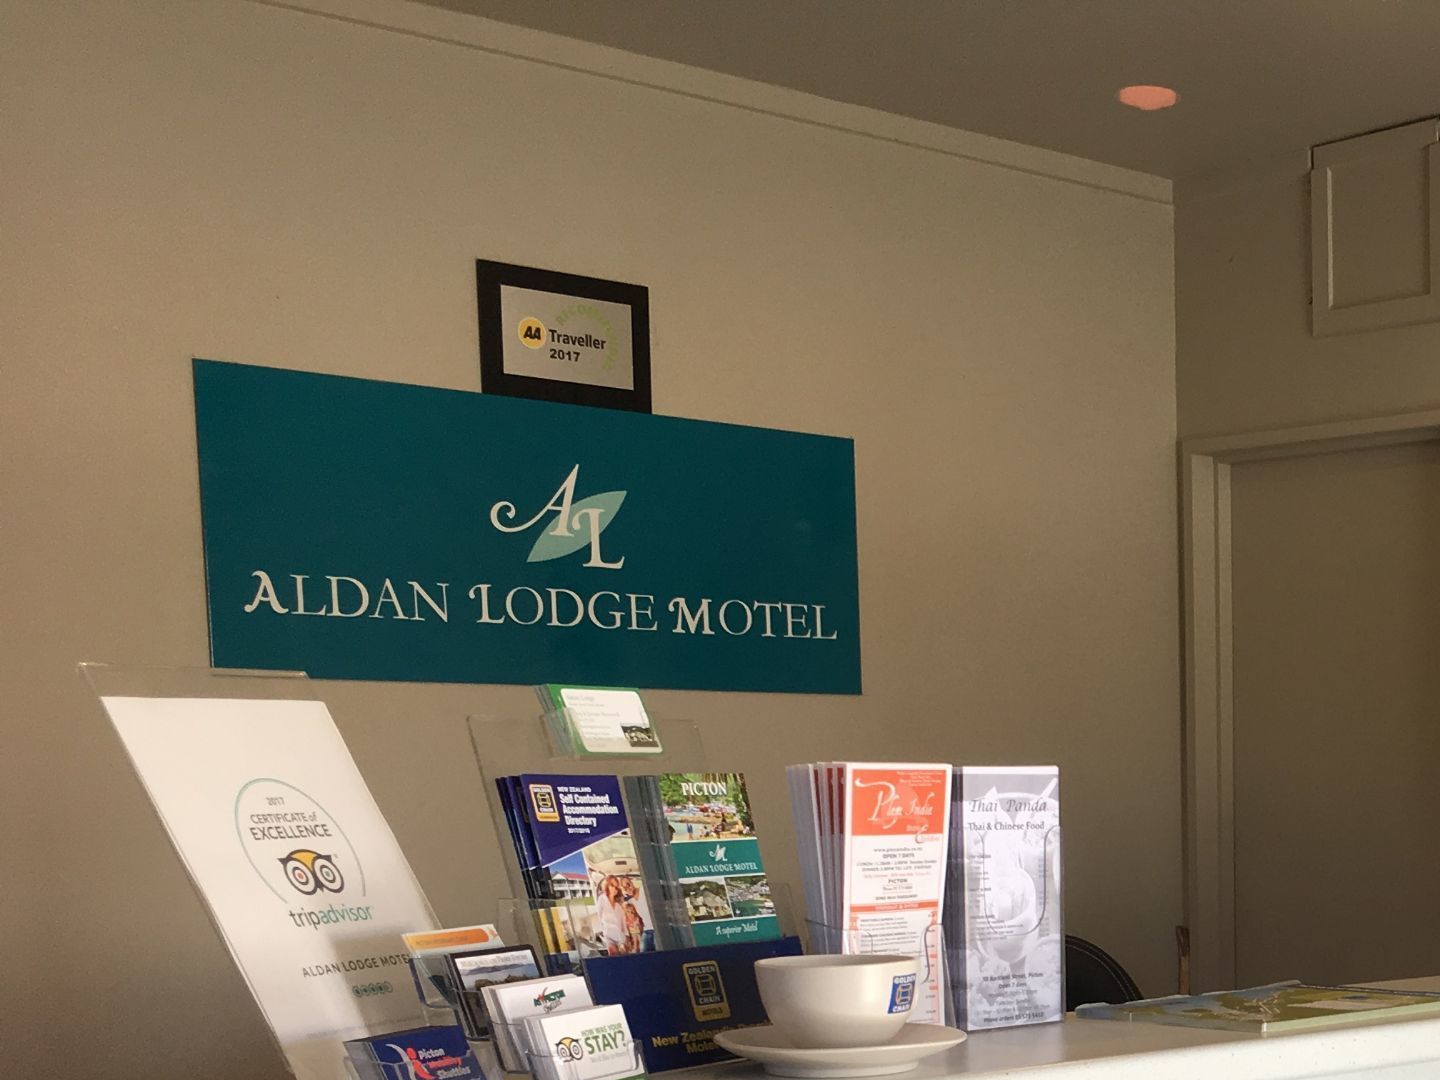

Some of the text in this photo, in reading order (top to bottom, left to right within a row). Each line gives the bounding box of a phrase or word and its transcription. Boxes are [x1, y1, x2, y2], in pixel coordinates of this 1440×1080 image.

[523, 325, 607, 350] AA Traveller
[549, 348, 581, 362] 2017
[244, 569, 838, 640] ALDAN LODGE MOTEL
[681, 782, 728, 796] PICTON
[559, 794, 611, 804] Self Contained
[968, 799, 1047, 813] Thai Panda
[563, 804, 619, 815] Accommodation
[250, 811, 318, 824] CERTIFICATE of
[564, 815, 597, 827] Directory
[249, 824, 332, 840] EXCELLENCE
[968, 821, 1045, 831] Thai & Chinese Food
[685, 861, 758, 875] ALDAN LODGE MOTEL
[288, 904, 373, 930] tripadvisor
[302, 953, 410, 978] ALDAN LODGE MOTE
[688, 966, 716, 975] GOLDEN
[584, 1030, 627, 1055] STAY?
[651, 1035, 679, 1048] New
[418, 1048, 445, 1060] Picton
